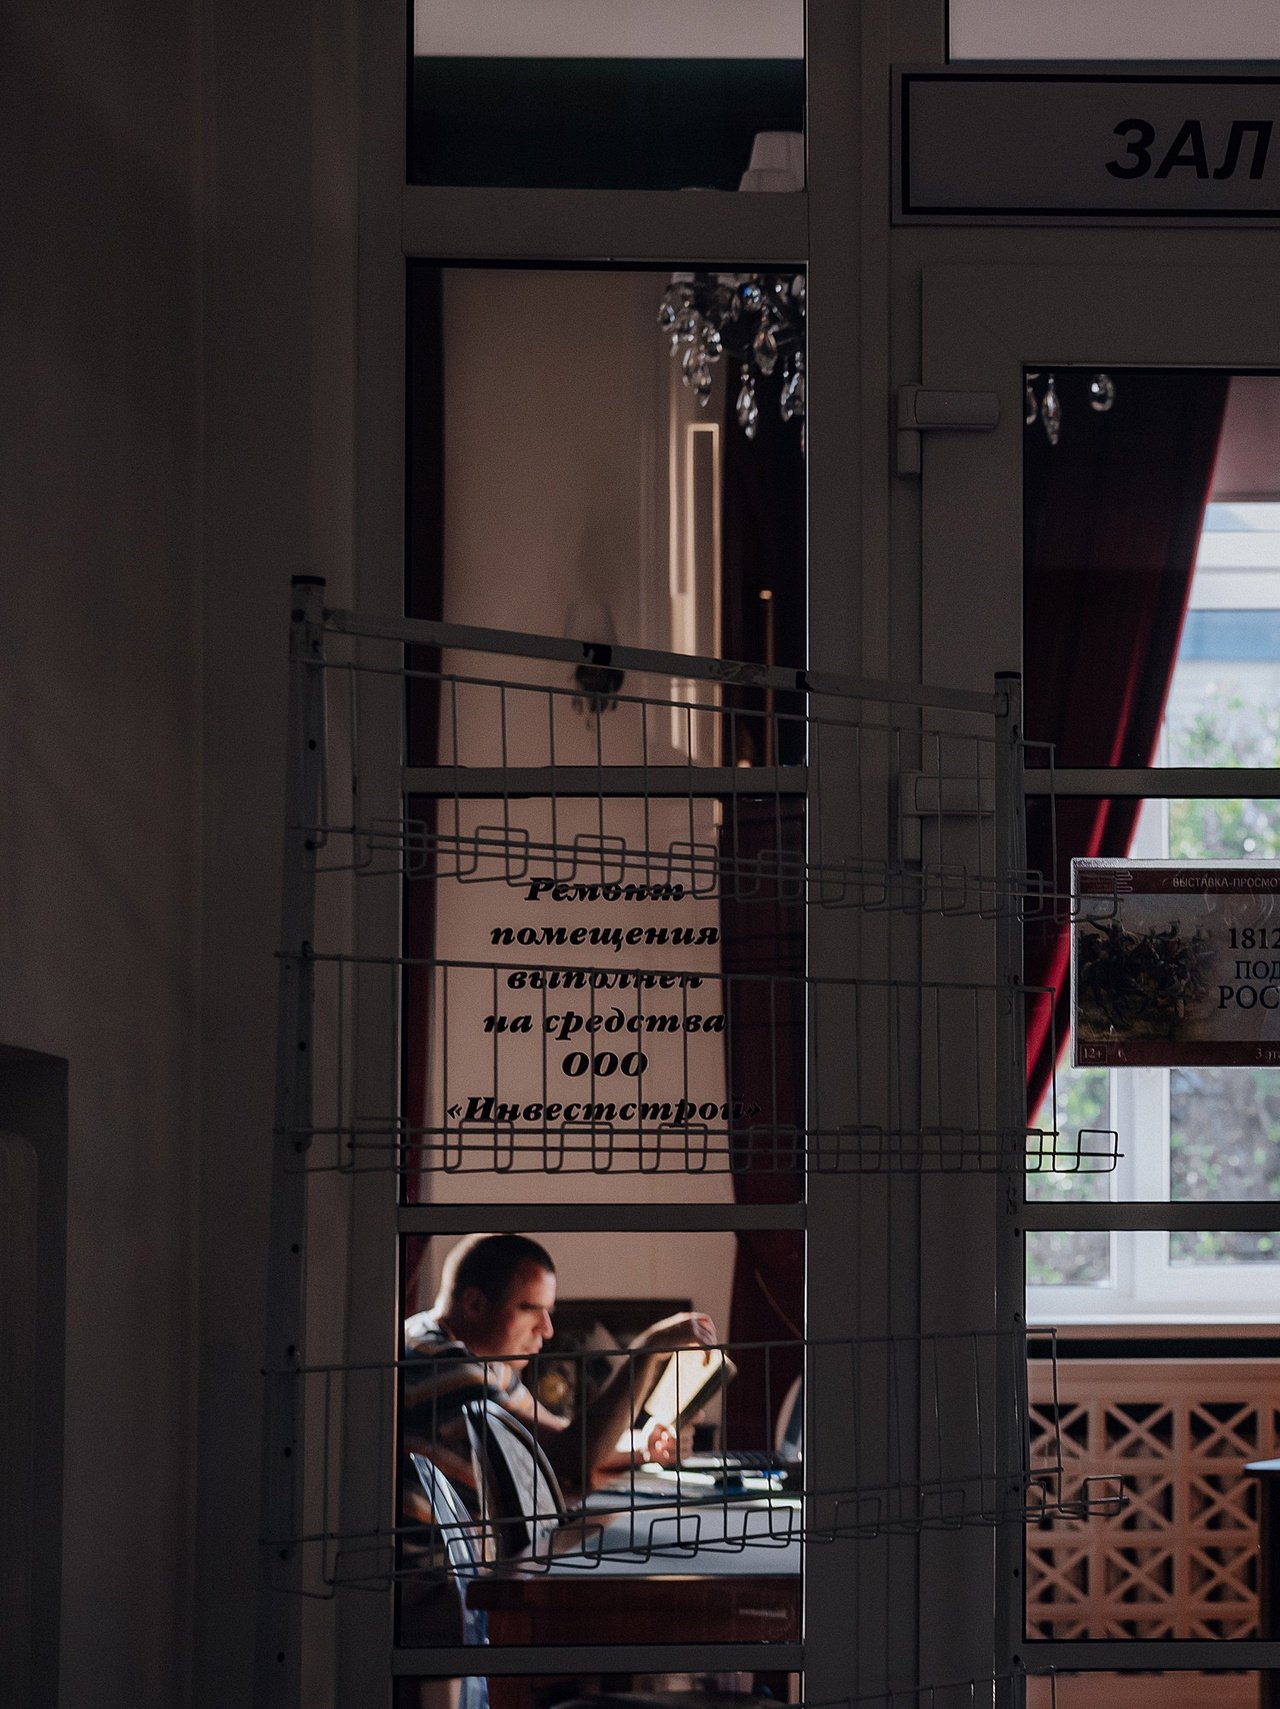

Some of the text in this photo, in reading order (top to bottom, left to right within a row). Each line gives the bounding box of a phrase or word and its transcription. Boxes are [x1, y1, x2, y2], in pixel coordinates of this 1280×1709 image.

[1105, 118, 1274, 181] ЗАЛ
[525, 877, 686, 902] Ремонт
[490, 926, 720, 952] помещения
[507, 968, 703, 990] выполнен
[484, 1008, 727, 1041] на средства
[561, 1051, 648, 1077] ООО
[1083, 1048, 1102, 1060] 12+
[447, 1095, 762, 1128] «Инвестстрой»
